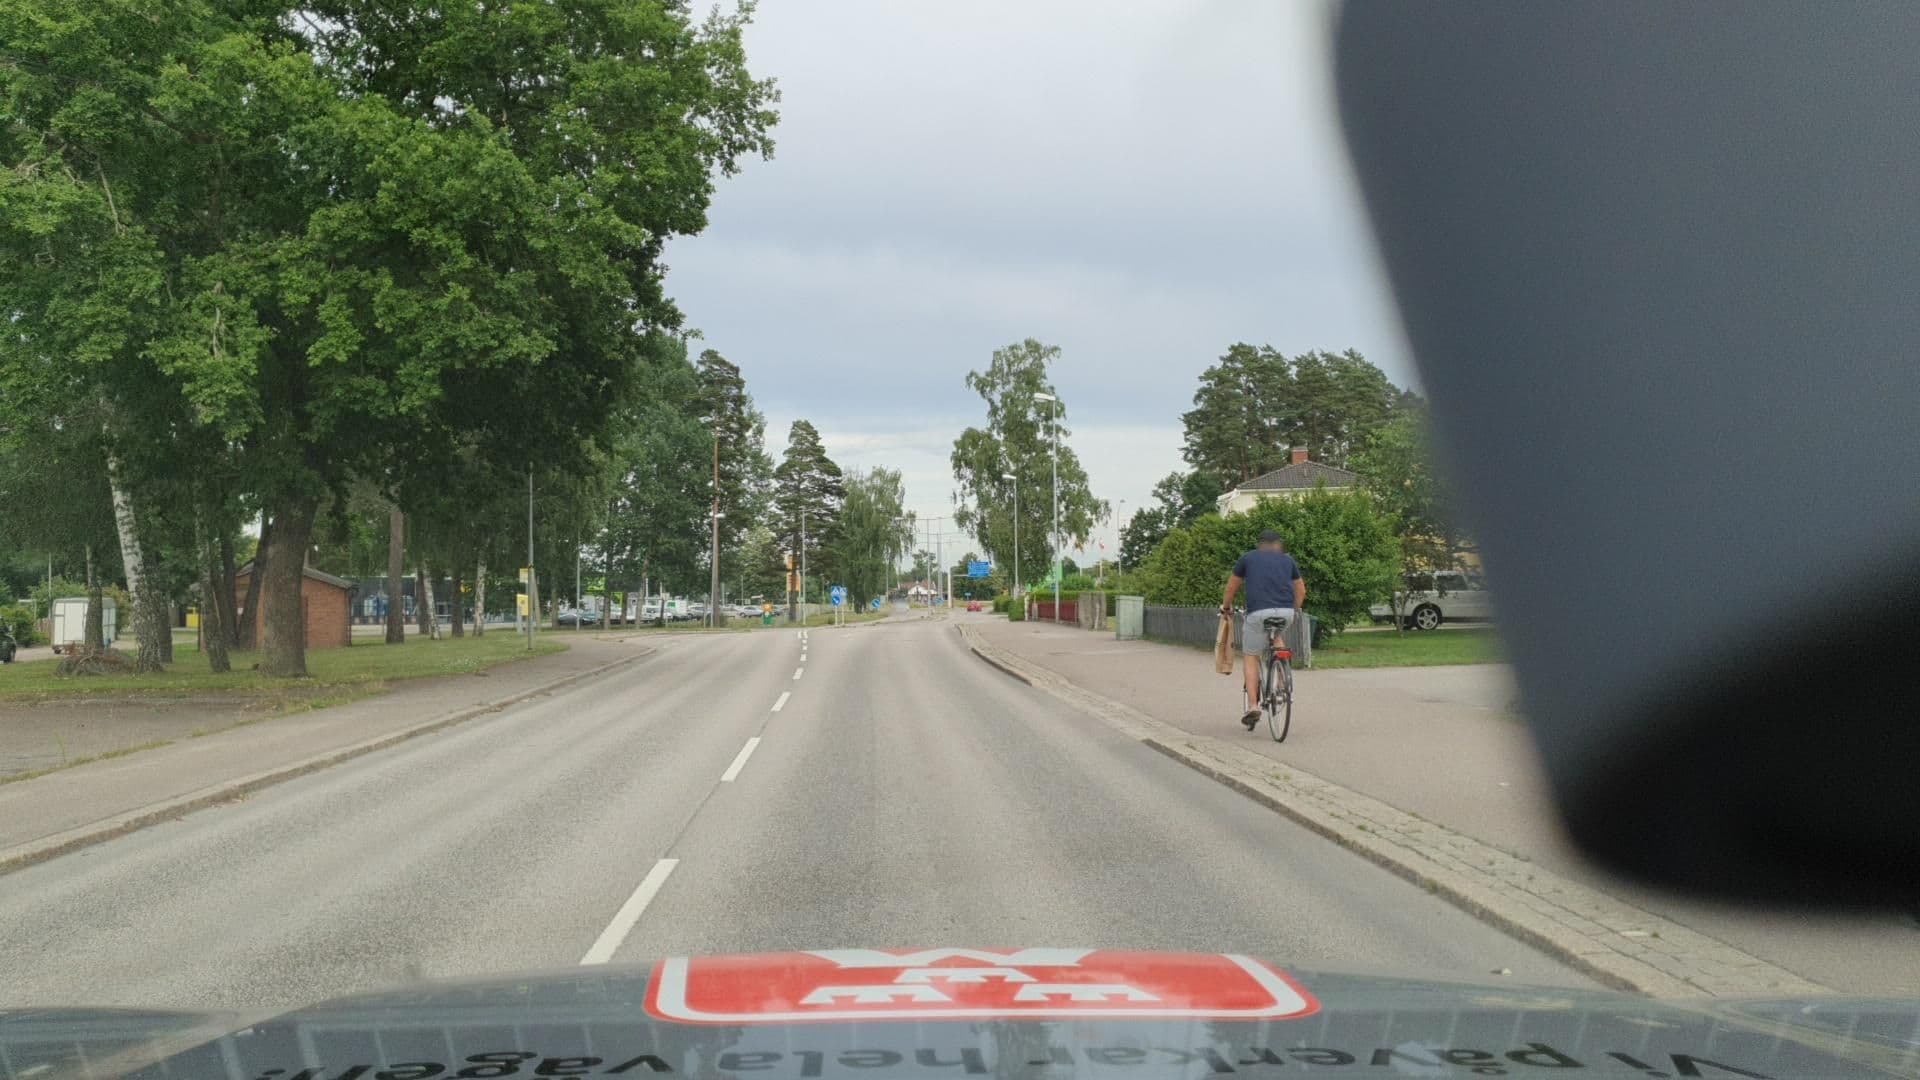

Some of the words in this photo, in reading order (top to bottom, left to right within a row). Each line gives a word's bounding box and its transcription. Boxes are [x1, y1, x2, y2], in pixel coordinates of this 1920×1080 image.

[716, 1048, 989, 1077] hela
[1028, 1042, 1586, 1076] påverkar
[1603, 1052, 1776, 1080] Vi
